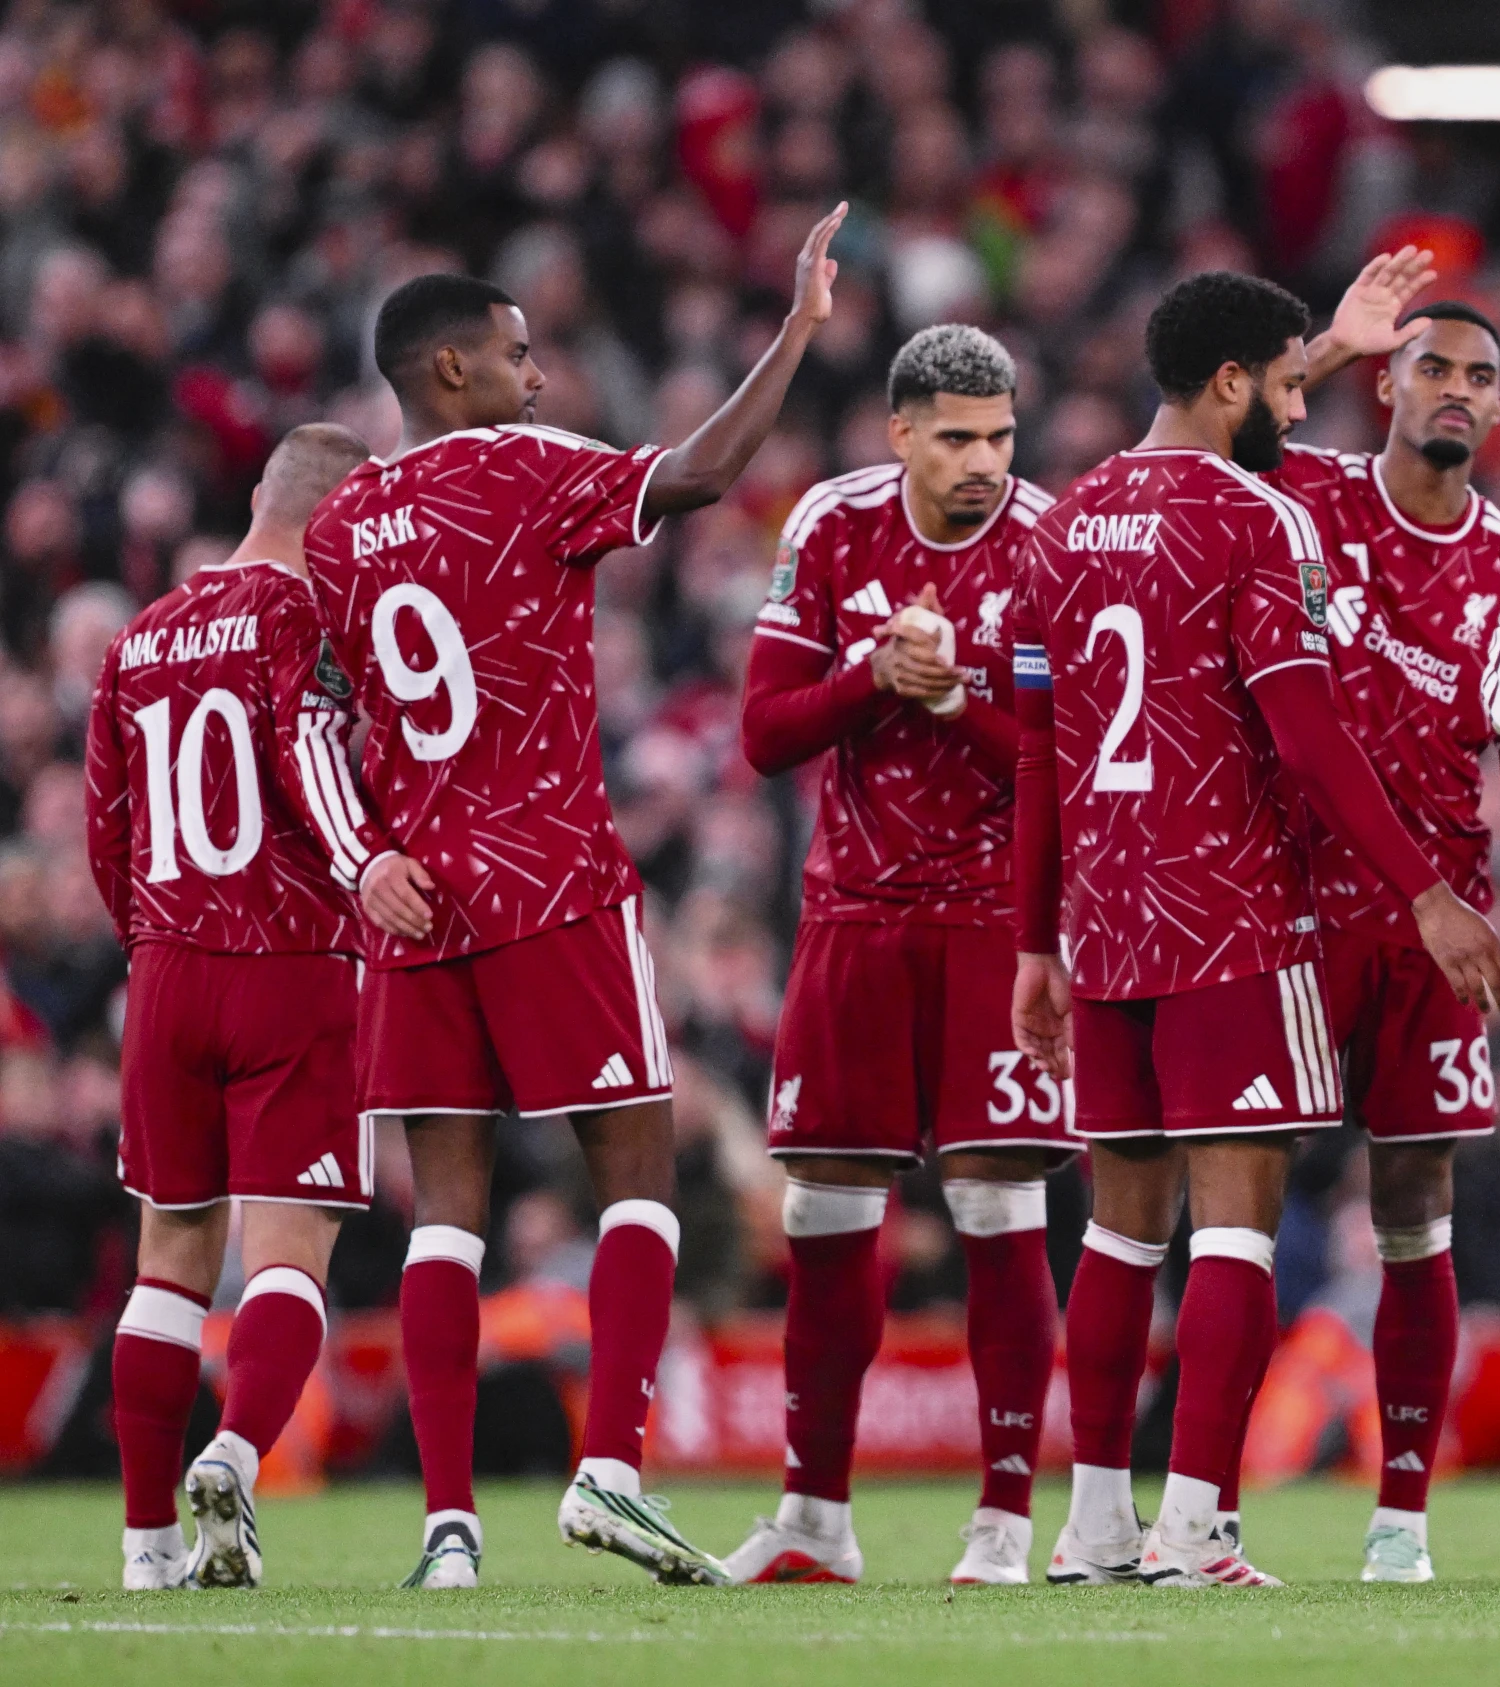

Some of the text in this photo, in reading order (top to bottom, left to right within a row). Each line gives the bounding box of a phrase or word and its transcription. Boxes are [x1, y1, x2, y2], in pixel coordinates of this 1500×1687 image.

[353, 504, 418, 560] ISAK
[1067, 514, 1162, 553] GOMEZ
[119, 628, 168, 673] MAC
[371, 582, 478, 762] 9
[1085, 604, 1153, 793] 2
[134, 686, 263, 884] 10
[987, 1050, 1061, 1125] 33
[1429, 1036, 1495, 1114] 38
[990, 1407, 1034, 1430] LFC
[1387, 1404, 1429, 1423] LFC
